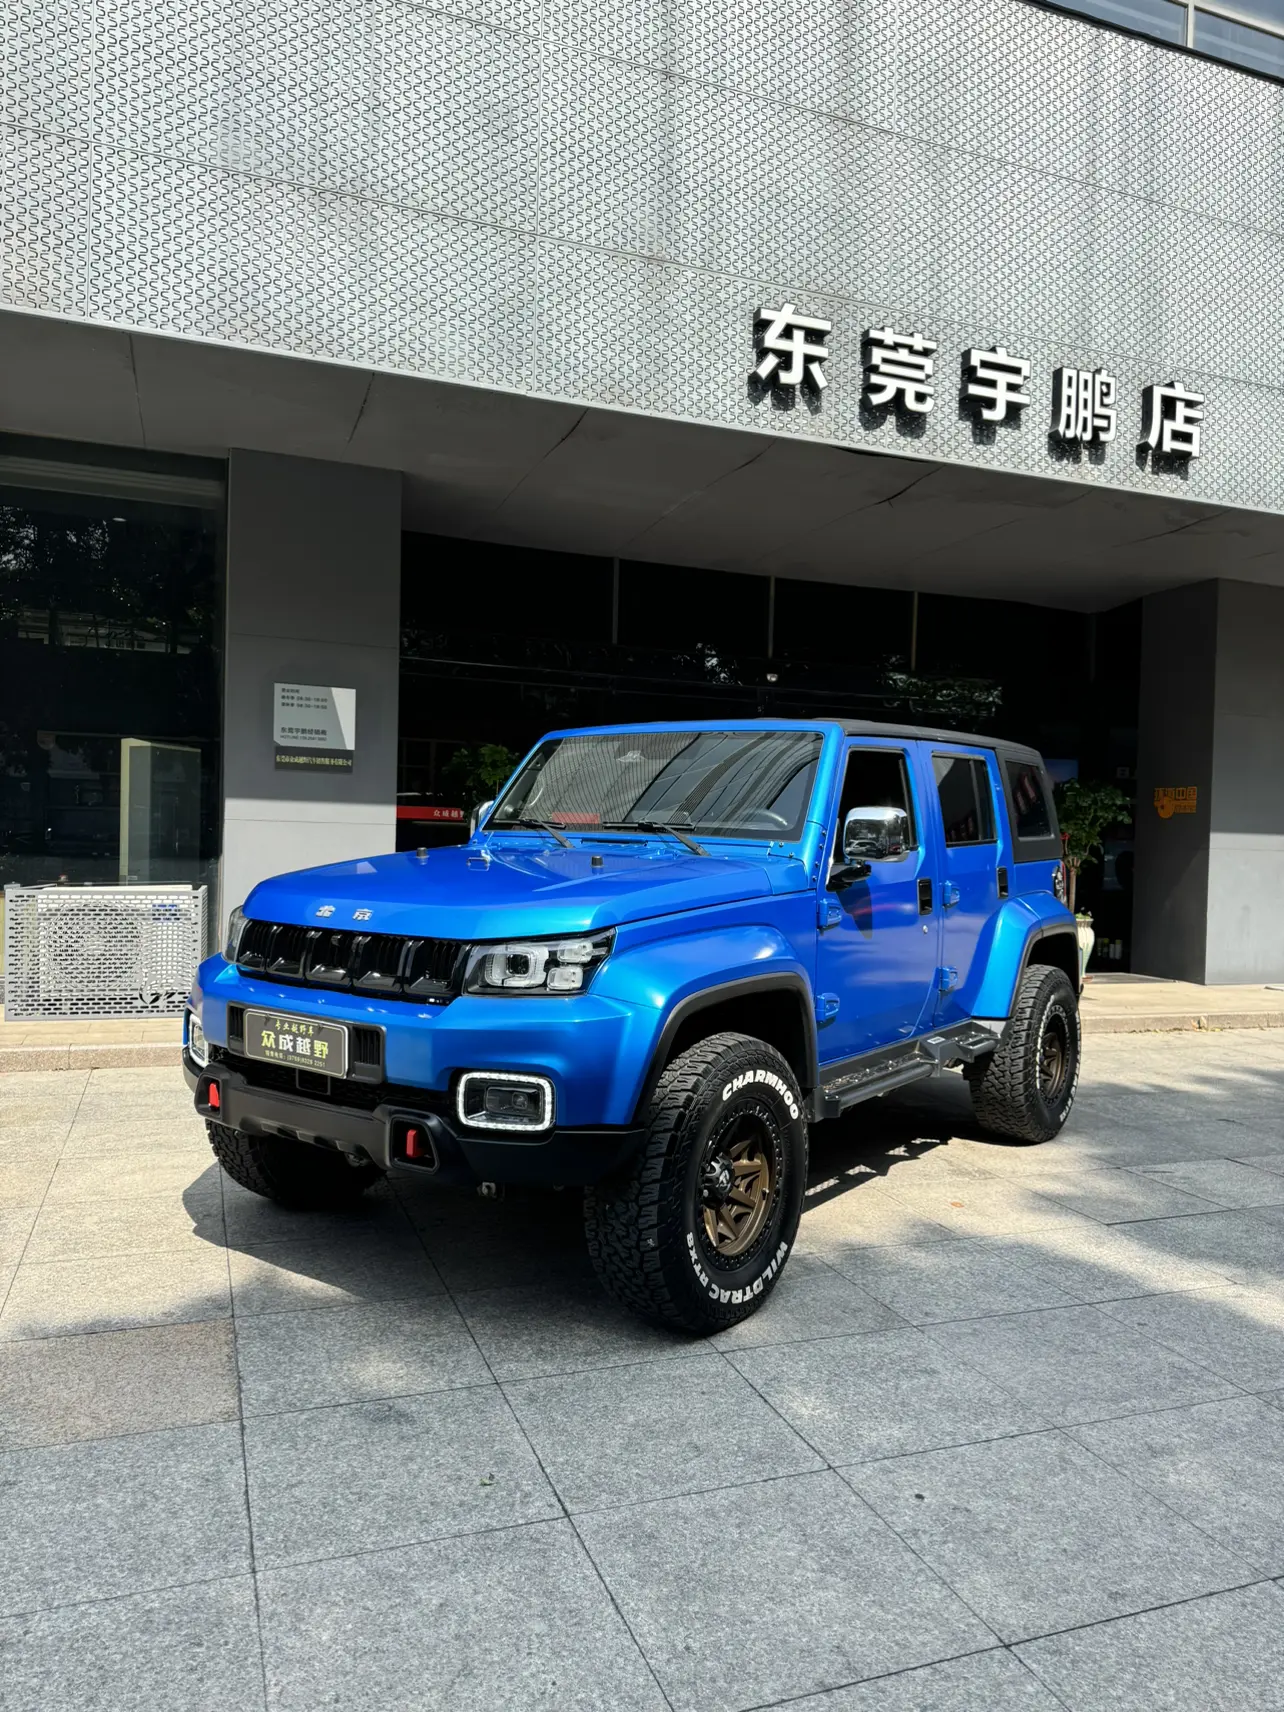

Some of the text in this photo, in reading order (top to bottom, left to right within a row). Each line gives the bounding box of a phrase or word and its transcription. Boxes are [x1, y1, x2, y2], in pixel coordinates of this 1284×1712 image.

[753, 302, 1206, 459] 东莞宇鹏店
[315, 905, 374, 921] 北京
[261, 1029, 328, 1059] 众成越野
[722, 1069, 799, 1120] CHARMHOO
[708, 1241, 788, 1305] WILDTRAC
